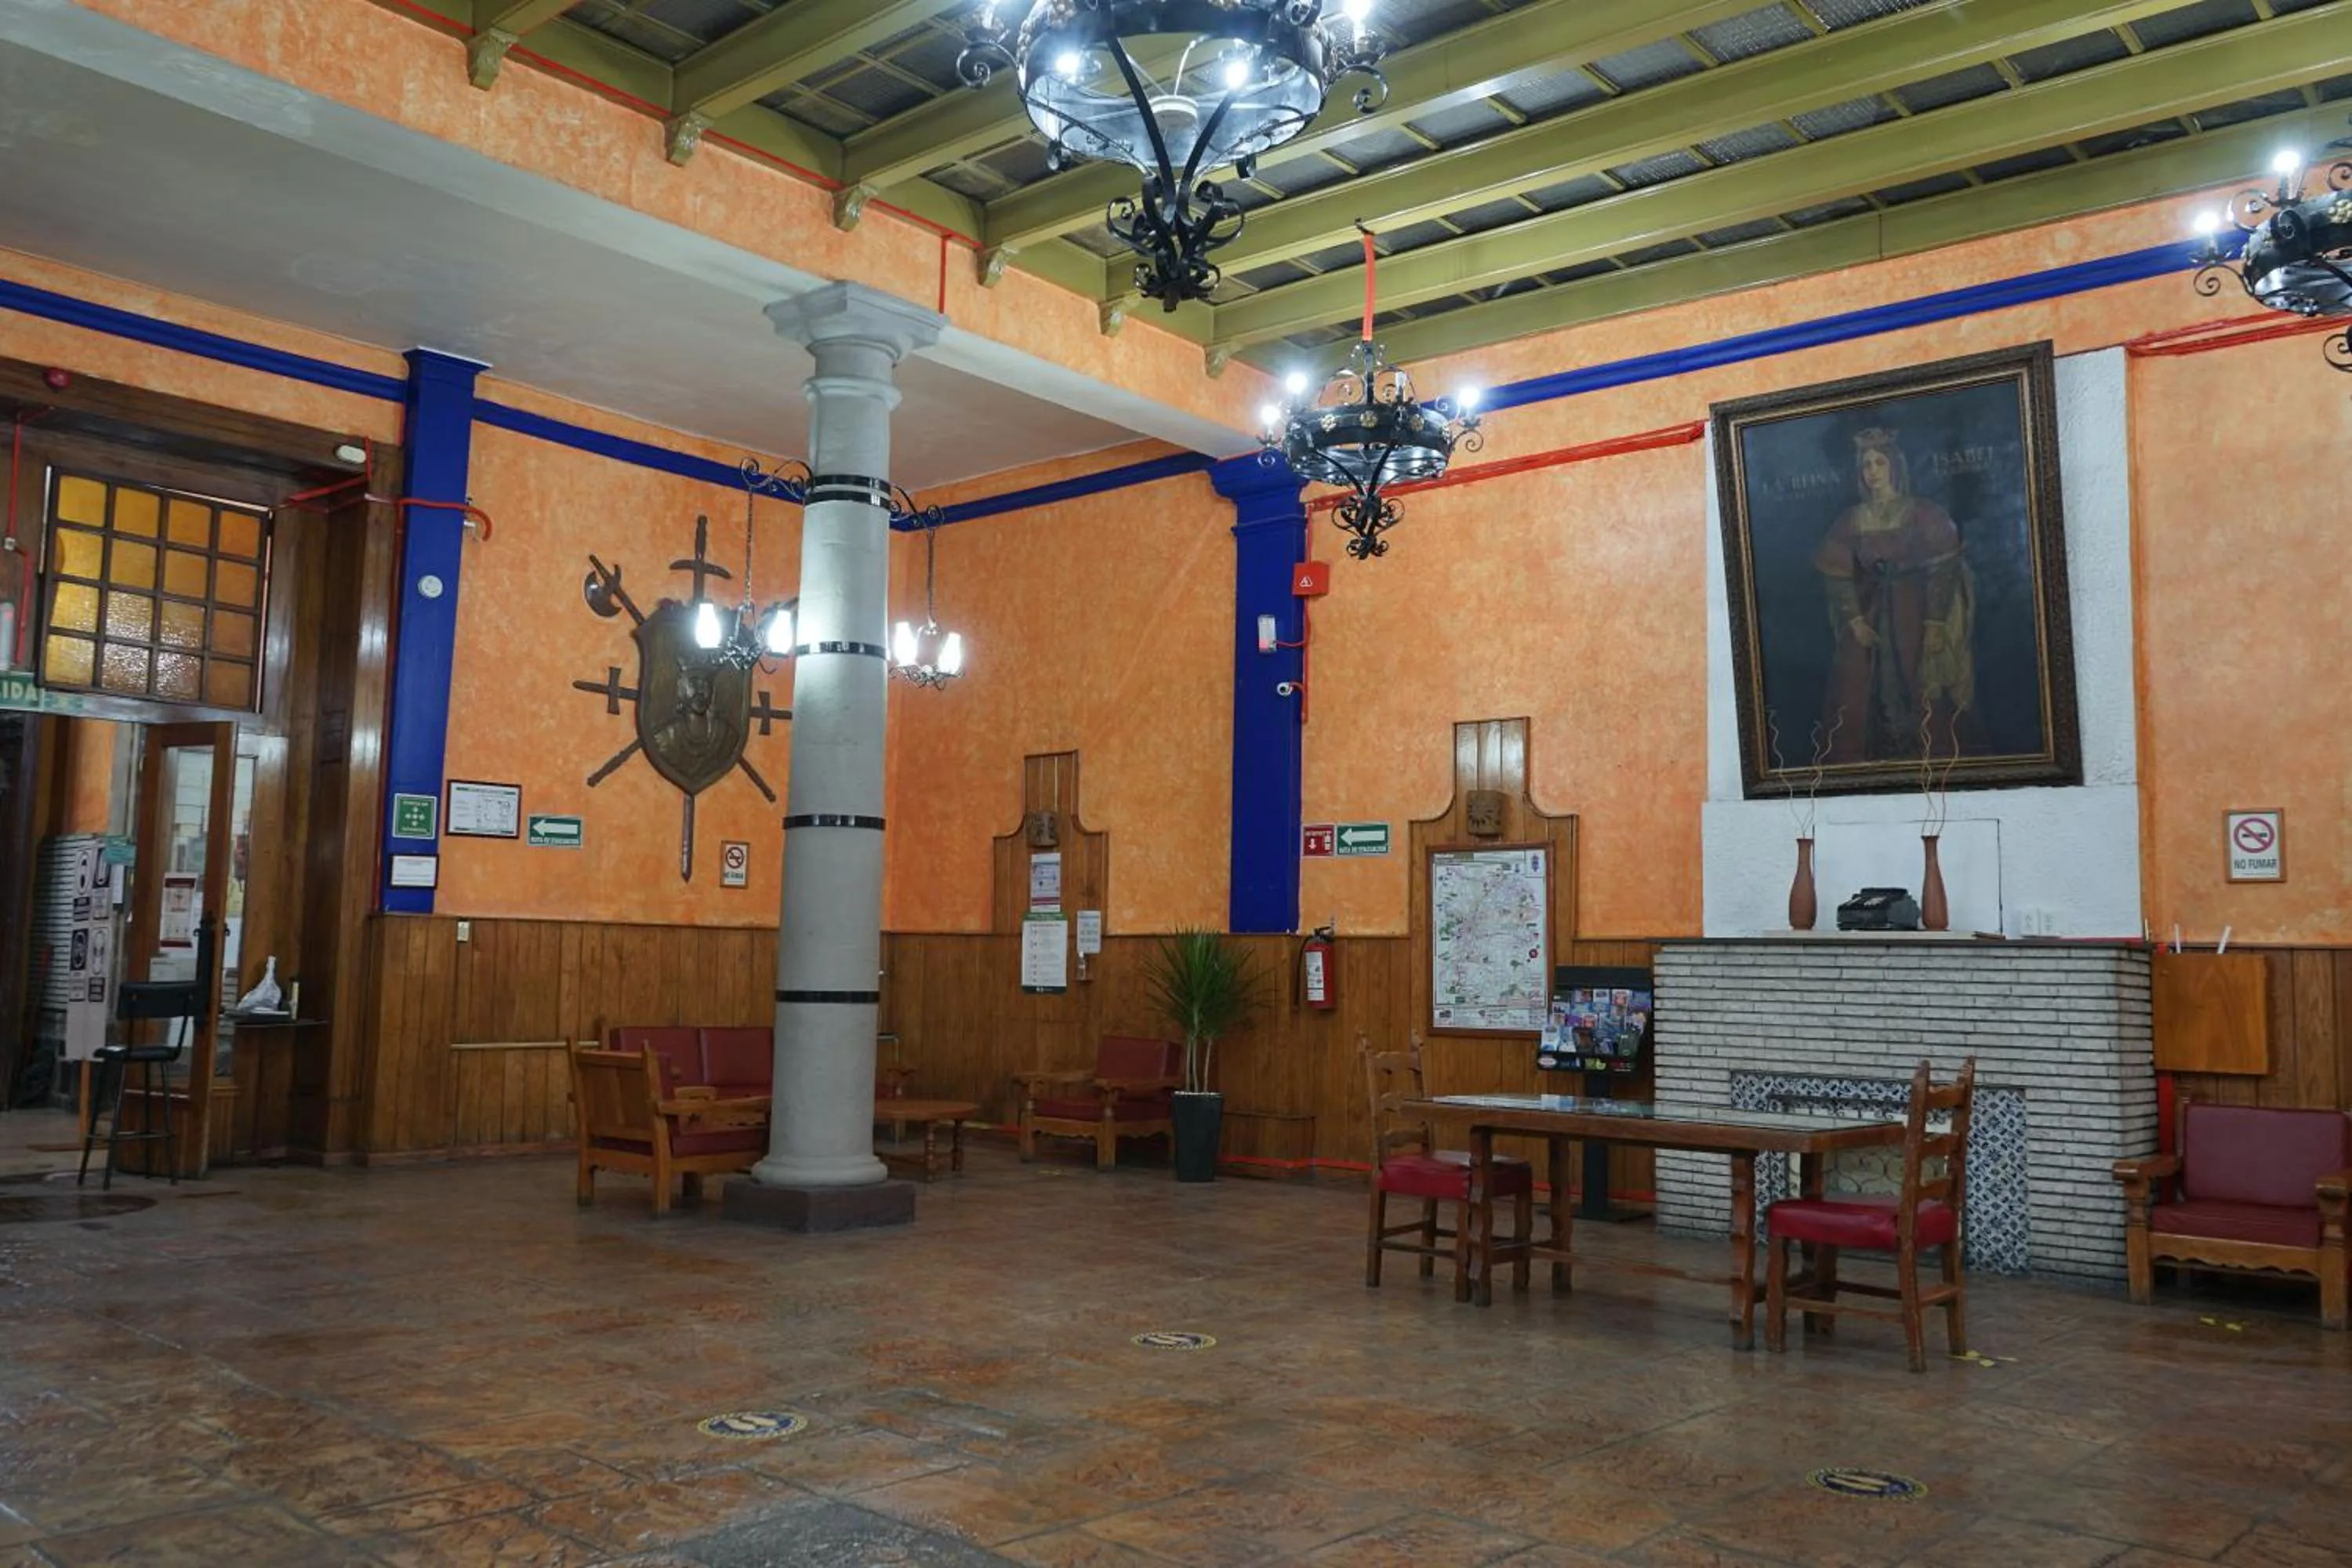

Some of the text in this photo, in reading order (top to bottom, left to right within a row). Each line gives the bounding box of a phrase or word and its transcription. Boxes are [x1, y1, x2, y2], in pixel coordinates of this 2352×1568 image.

[0, 680, 38, 702] IDA
[2234, 858, 2277, 869] NO FUMAR
